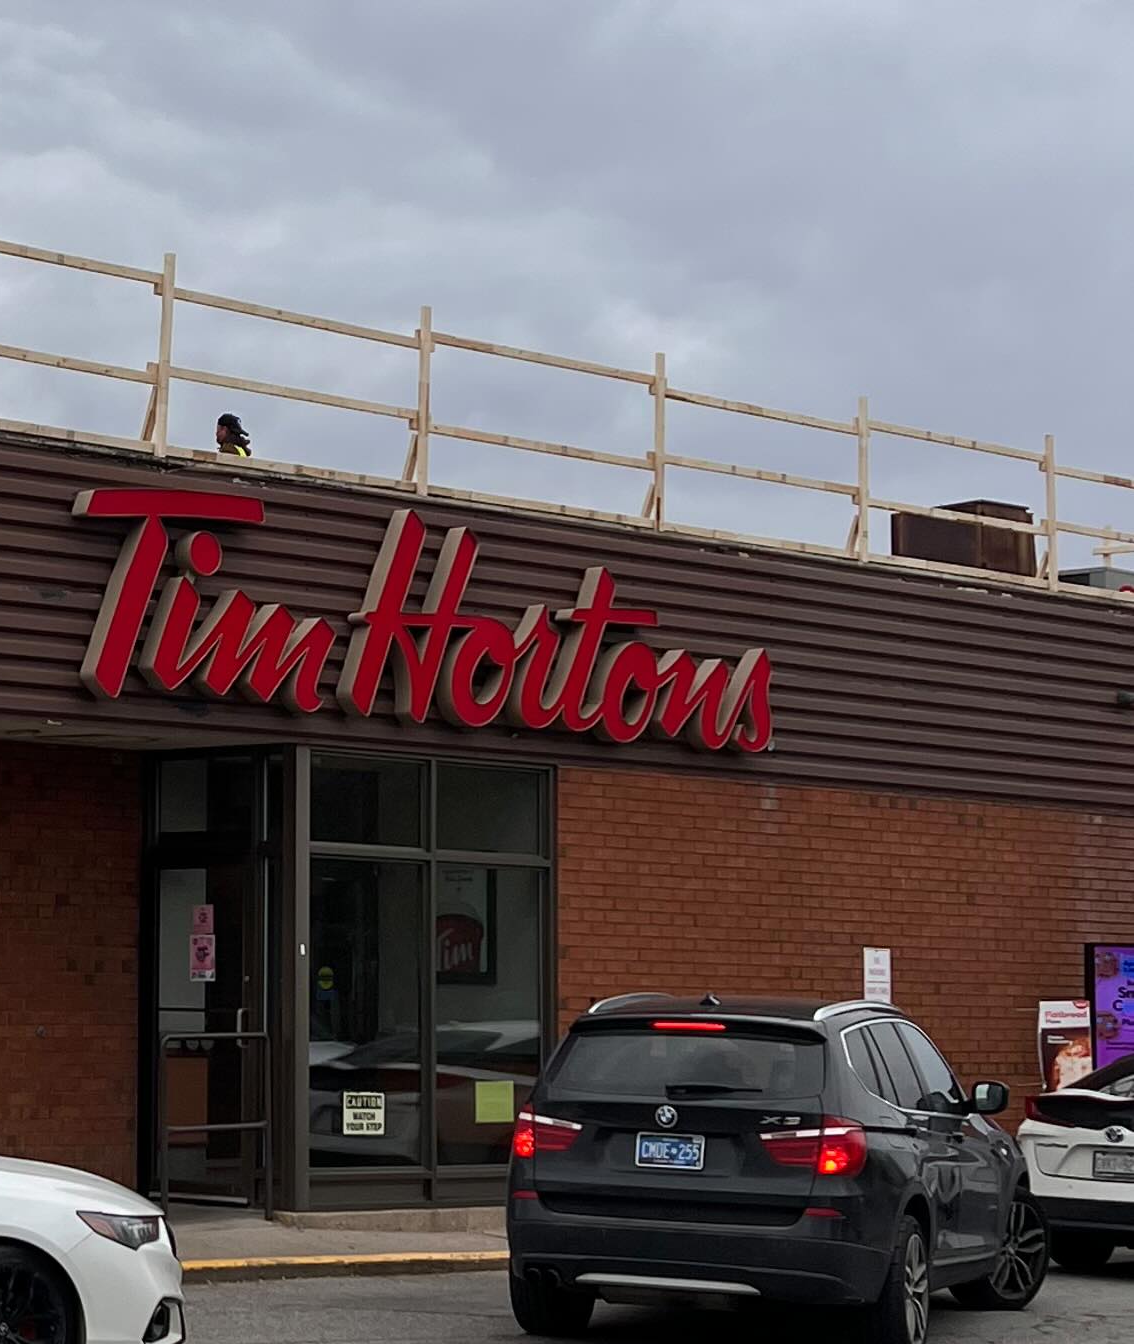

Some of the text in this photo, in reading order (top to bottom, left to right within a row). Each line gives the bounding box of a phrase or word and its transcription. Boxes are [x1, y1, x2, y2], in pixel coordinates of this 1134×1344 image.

[73, 488, 774, 752] Tim Hortons
[759, 1116, 801, 1125] X3
